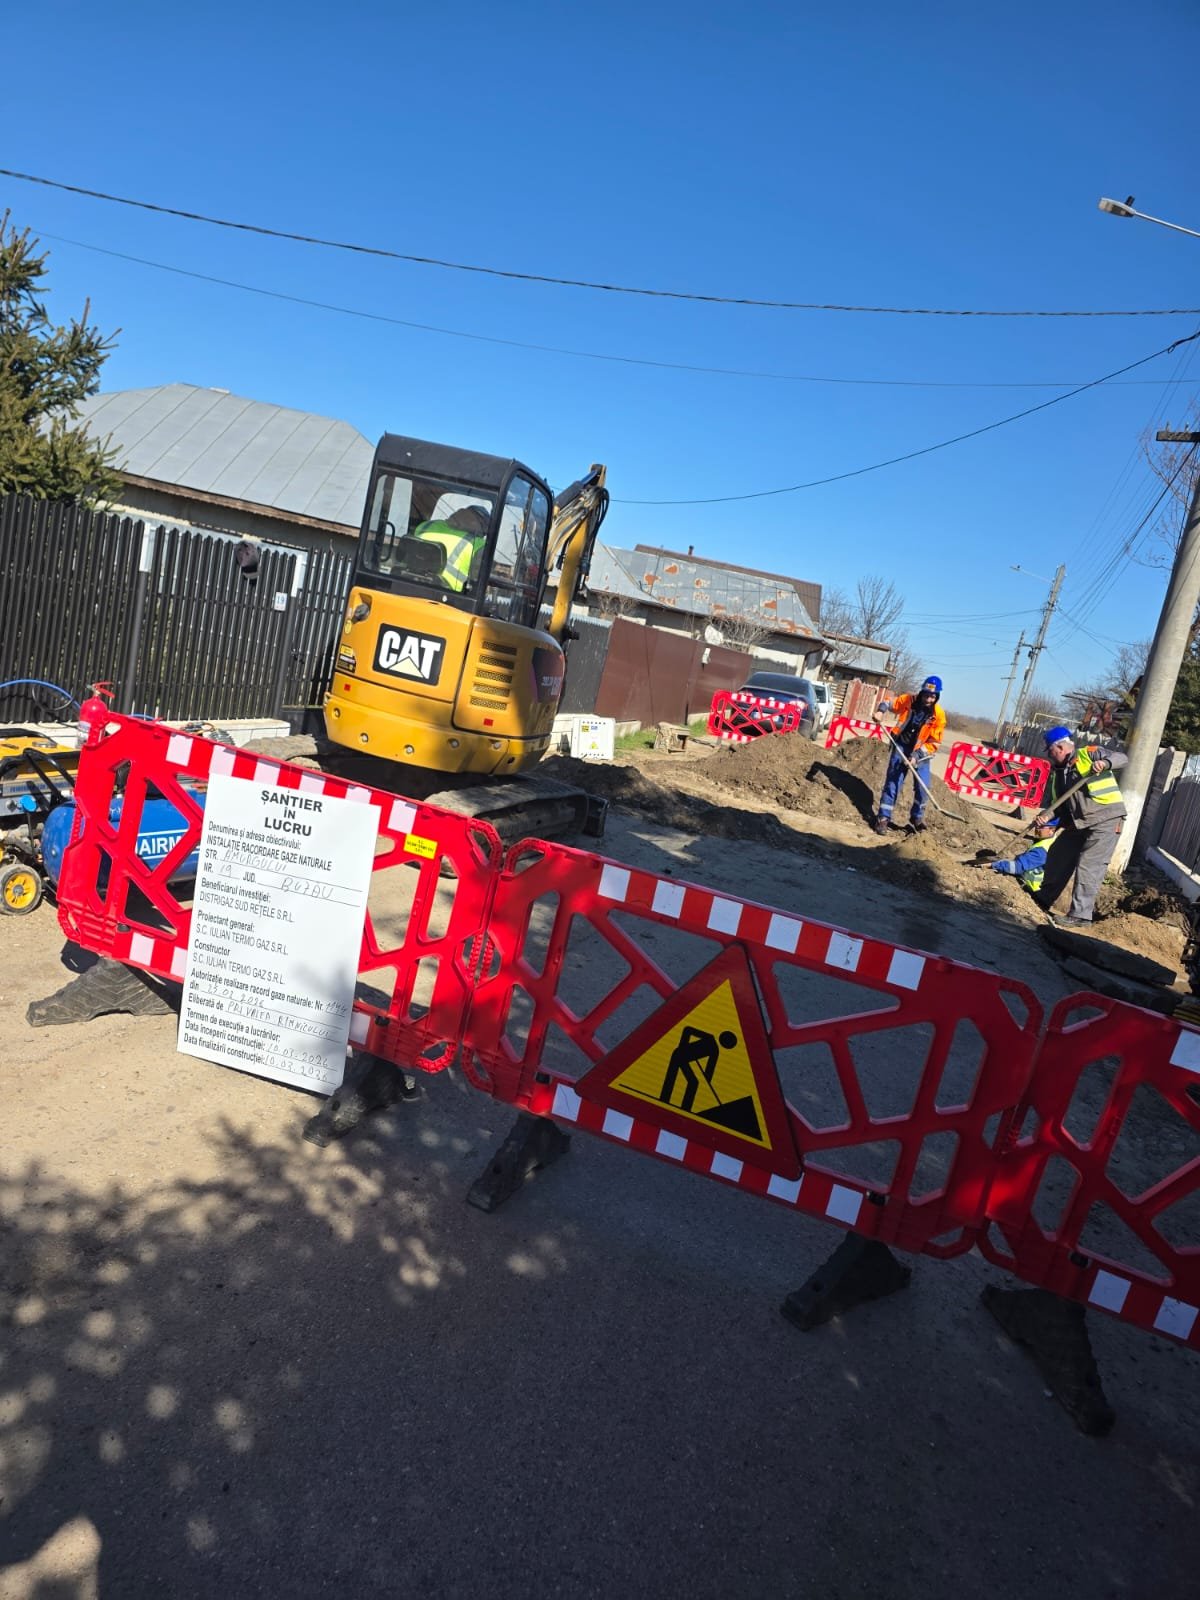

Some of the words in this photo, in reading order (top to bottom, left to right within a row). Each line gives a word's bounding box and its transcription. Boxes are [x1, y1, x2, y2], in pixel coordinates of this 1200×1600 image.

[379, 631, 441, 679] CAT
[261, 790, 322, 812] ȘANTIER
[283, 807, 295, 819] ÎN
[208, 820, 238, 836] Denumirea
[239, 828, 245, 840] și
[245, 830, 265, 842] adresa
[264, 817, 312, 836] LUCRU
[241, 842, 279, 859] RACORDARE
[281, 851, 298, 863] GAZE
[298, 855, 332, 871] NATURALE
[204, 862, 213, 873] NR.
[220, 864, 232, 877] 19
[243, 871, 256, 883] JUD.
[201, 877, 238, 894] Beneficiarul
[199, 891, 234, 908] DISTRIGAZ
[234, 899, 248, 911] SUD
[249, 903, 275, 918] REȚELE
[197, 910, 228, 926] Proiectant
[229, 920, 254, 932] general:
[194, 938, 230, 956] Constructor
[210, 927, 230, 941] IULIAN
[232, 932, 255, 946] TERMO
[256, 938, 270, 951] GAZ
[206, 955, 227, 970] IULIAN
[229, 961, 251, 975] TERMO
[252, 967, 266, 980] GAZ
[189, 981, 199, 990] din
[191, 968, 222, 987] Autorizație
[223, 978, 248, 991] realizare
[250, 985, 270, 997] racord
[270, 991, 285, 1000] gaze
[286, 995, 313, 1008] naturale:
[314, 1000, 323, 1010] Nr.
[216, 1000, 223, 1010] de
[185, 1020, 199, 1031] Data
[187, 1008, 208, 1022] Termen
[209, 1015, 217, 1024] de
[184, 1033, 197, 1045] Data
